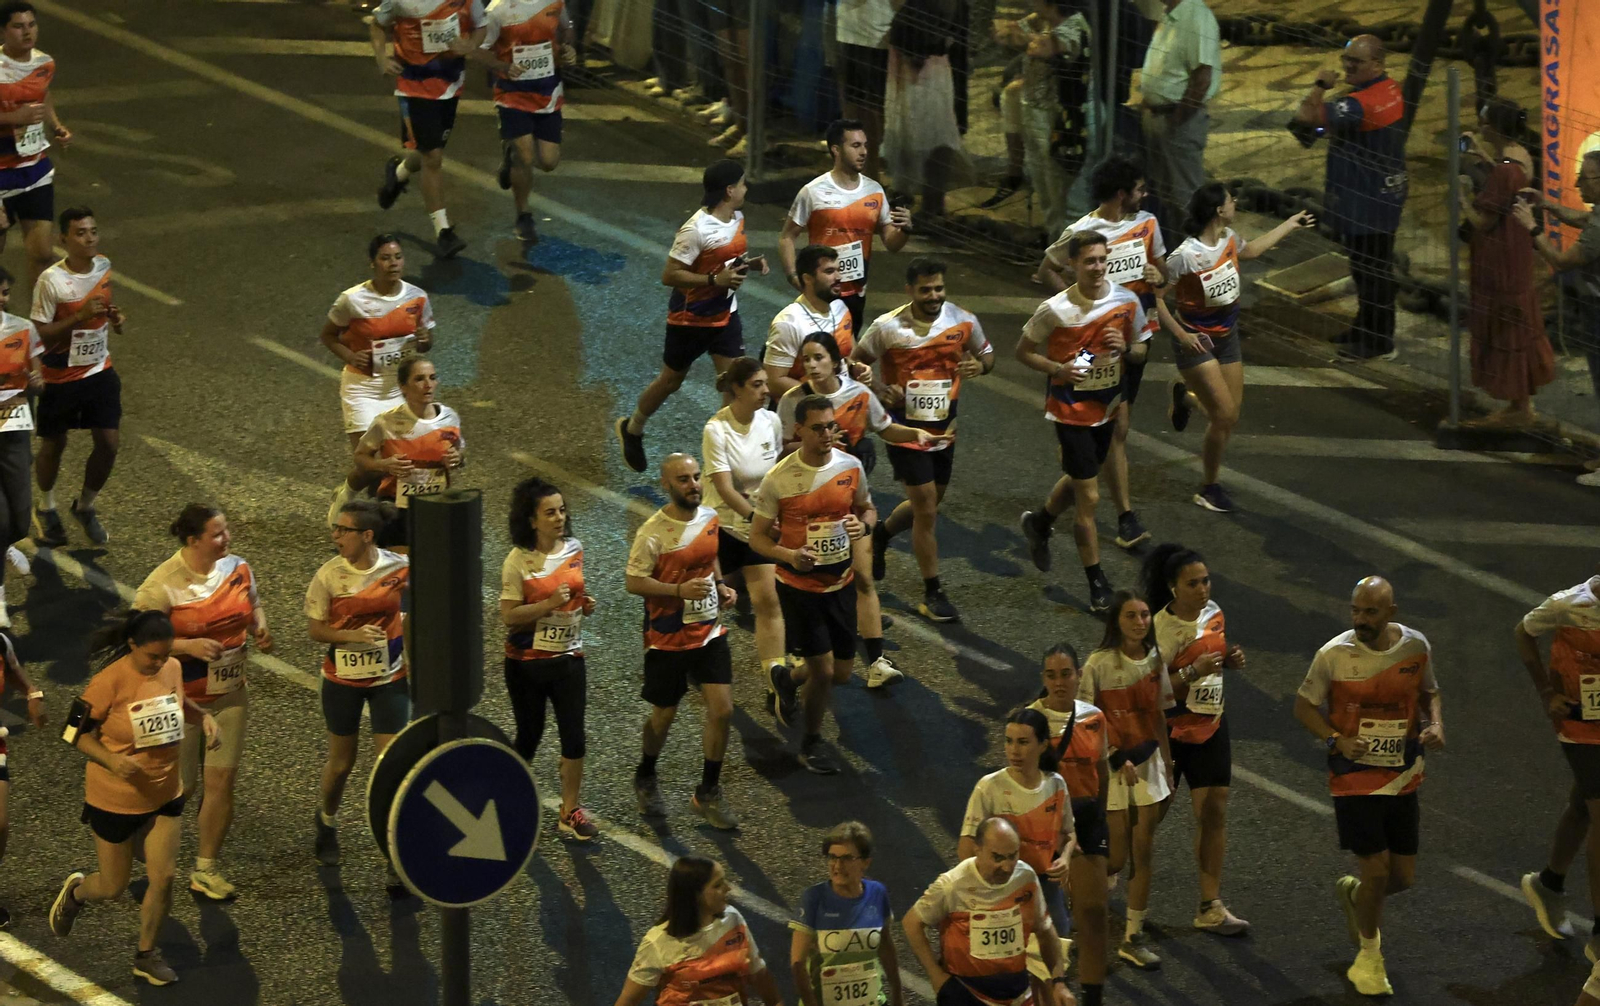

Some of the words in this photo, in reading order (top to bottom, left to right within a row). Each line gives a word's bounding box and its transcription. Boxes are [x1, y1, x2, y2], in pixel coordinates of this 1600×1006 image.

[839, 257, 859, 272] 990
[1107, 255, 1142, 274] 22302
[1209, 277, 1237, 299] 22253
[1086, 365, 1115, 381] 1515
[911, 396, 946, 410] 16931
[813, 535, 846, 553] 16532
[341, 650, 383, 667] 19172
[139, 713, 179, 735] 12815
[1369, 738, 1402, 754] 2486
[981, 927, 1016, 946] 3190
[834, 981, 869, 1002] 3182
